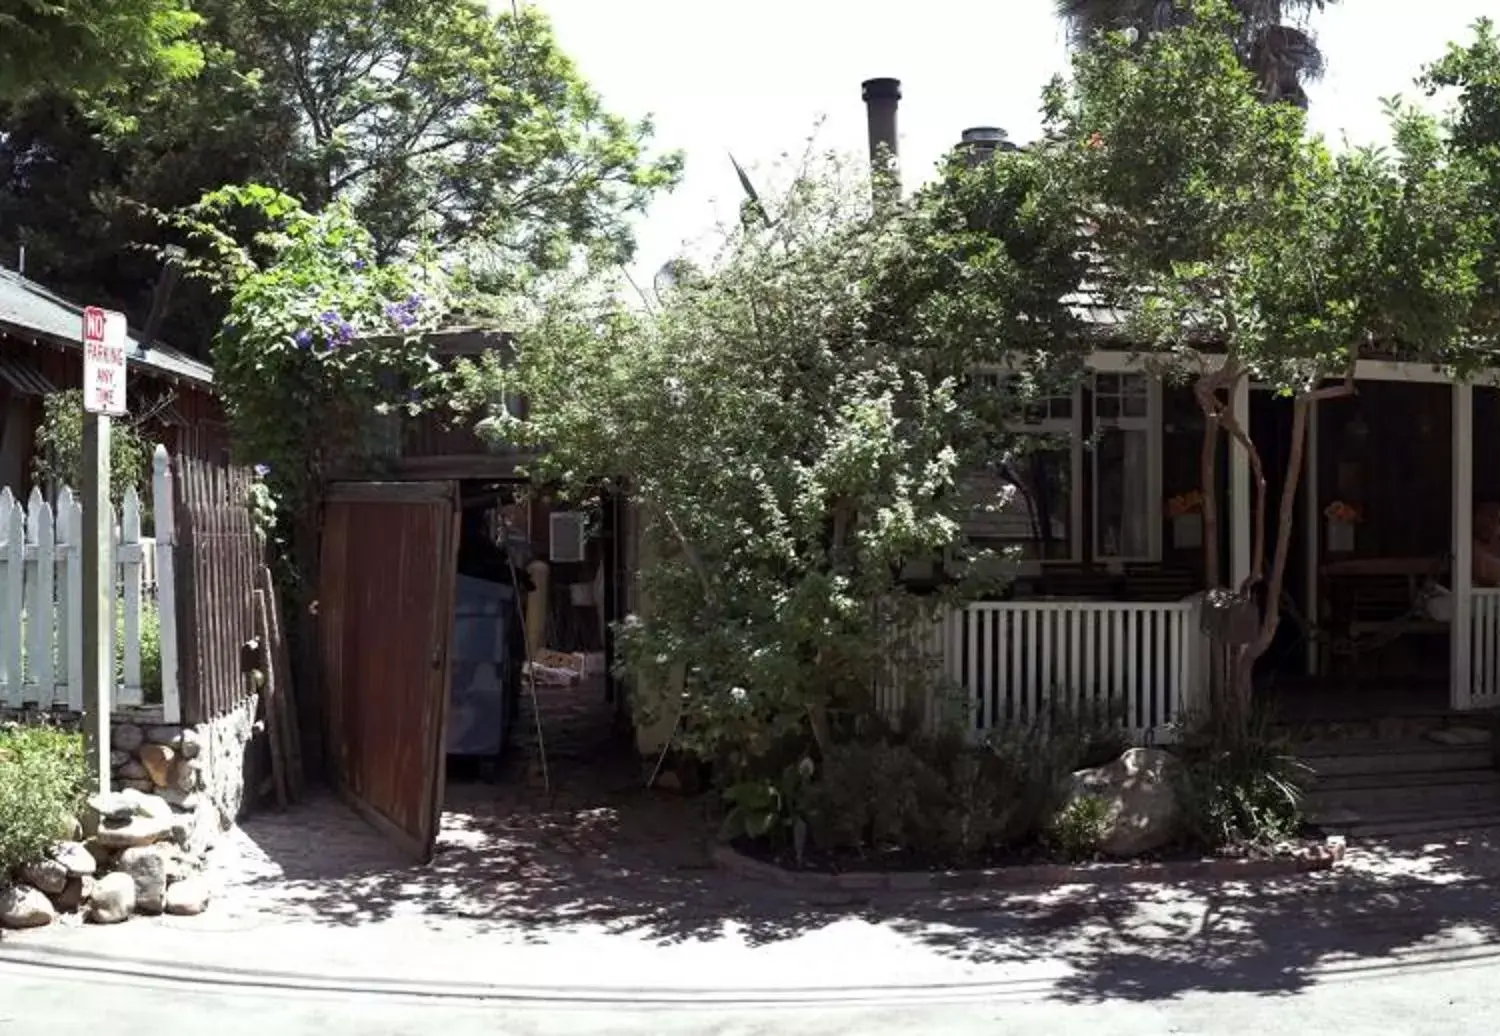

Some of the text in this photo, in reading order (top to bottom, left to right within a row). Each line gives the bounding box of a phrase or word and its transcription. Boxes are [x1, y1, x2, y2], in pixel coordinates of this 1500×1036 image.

[87, 312, 103, 339] NO
[87, 342, 123, 367] PARKING
[96, 367, 114, 384] ANY
[95, 387, 115, 405] TIME
